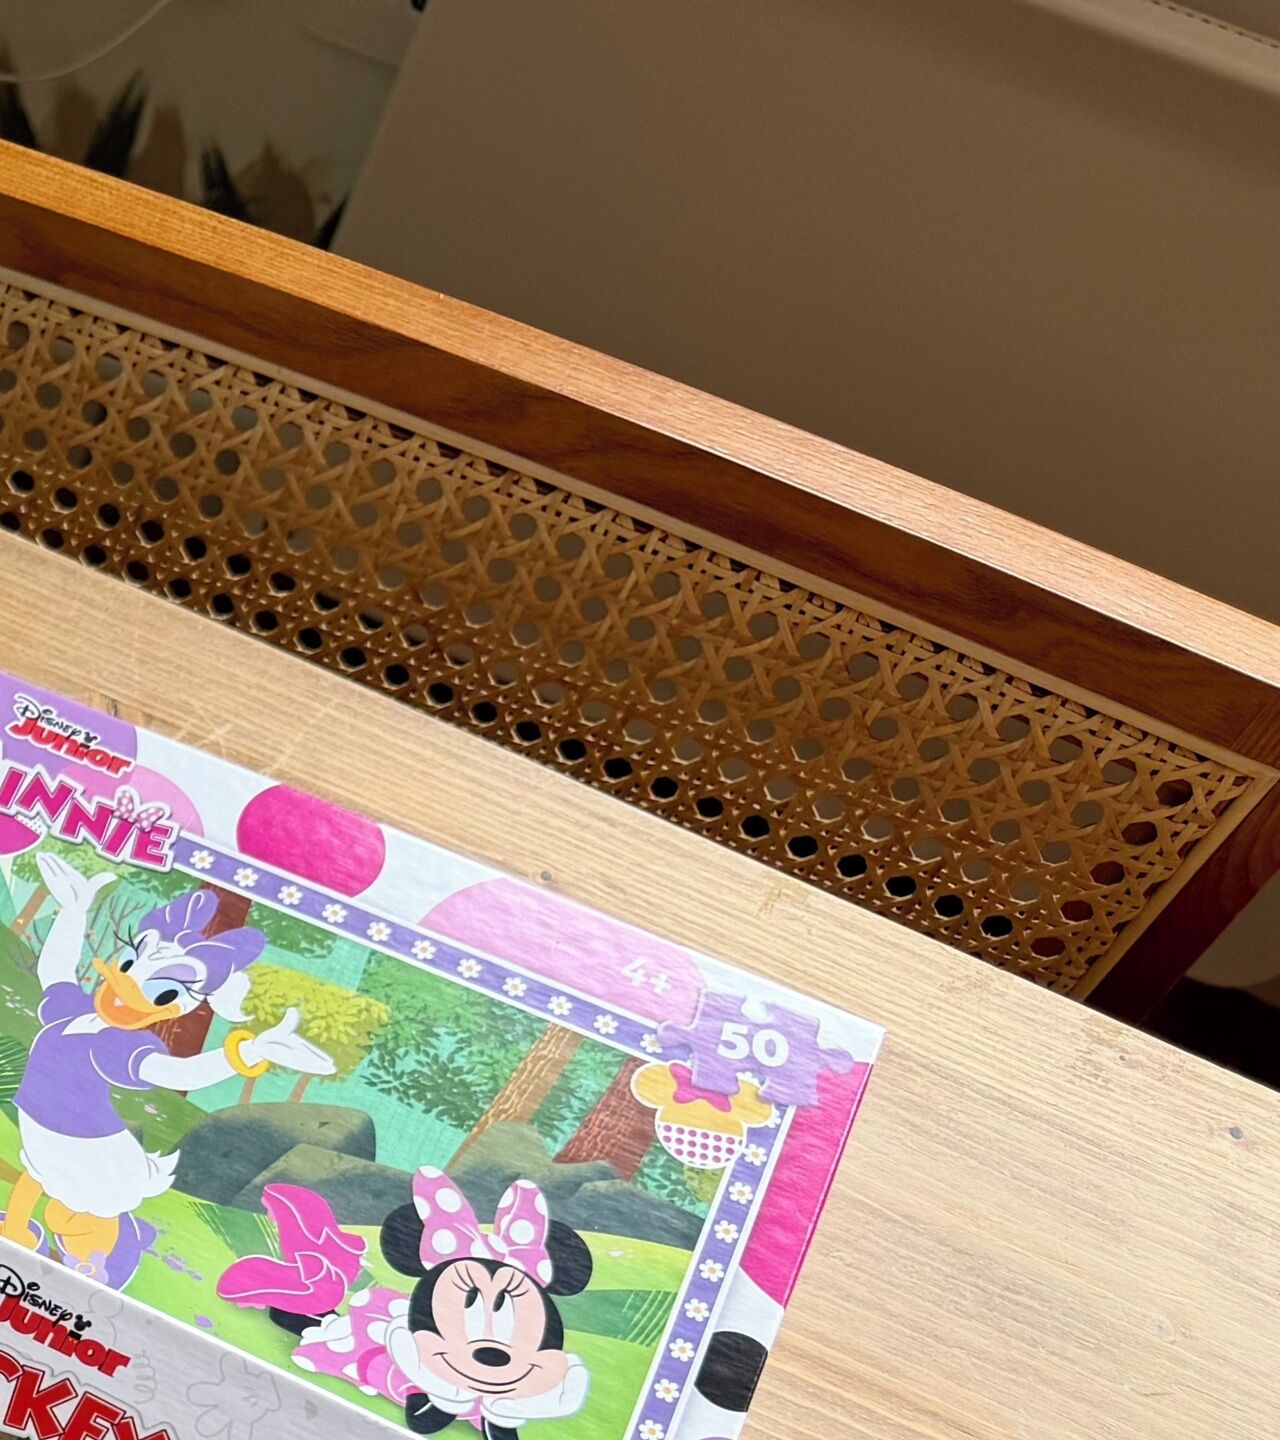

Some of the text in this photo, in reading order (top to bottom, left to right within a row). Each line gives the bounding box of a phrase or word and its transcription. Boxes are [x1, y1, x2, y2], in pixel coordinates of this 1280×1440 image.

[14, 695, 83, 738] Disney
[621, 957, 673, 994] 4+
[717, 1021, 790, 1067] 50
